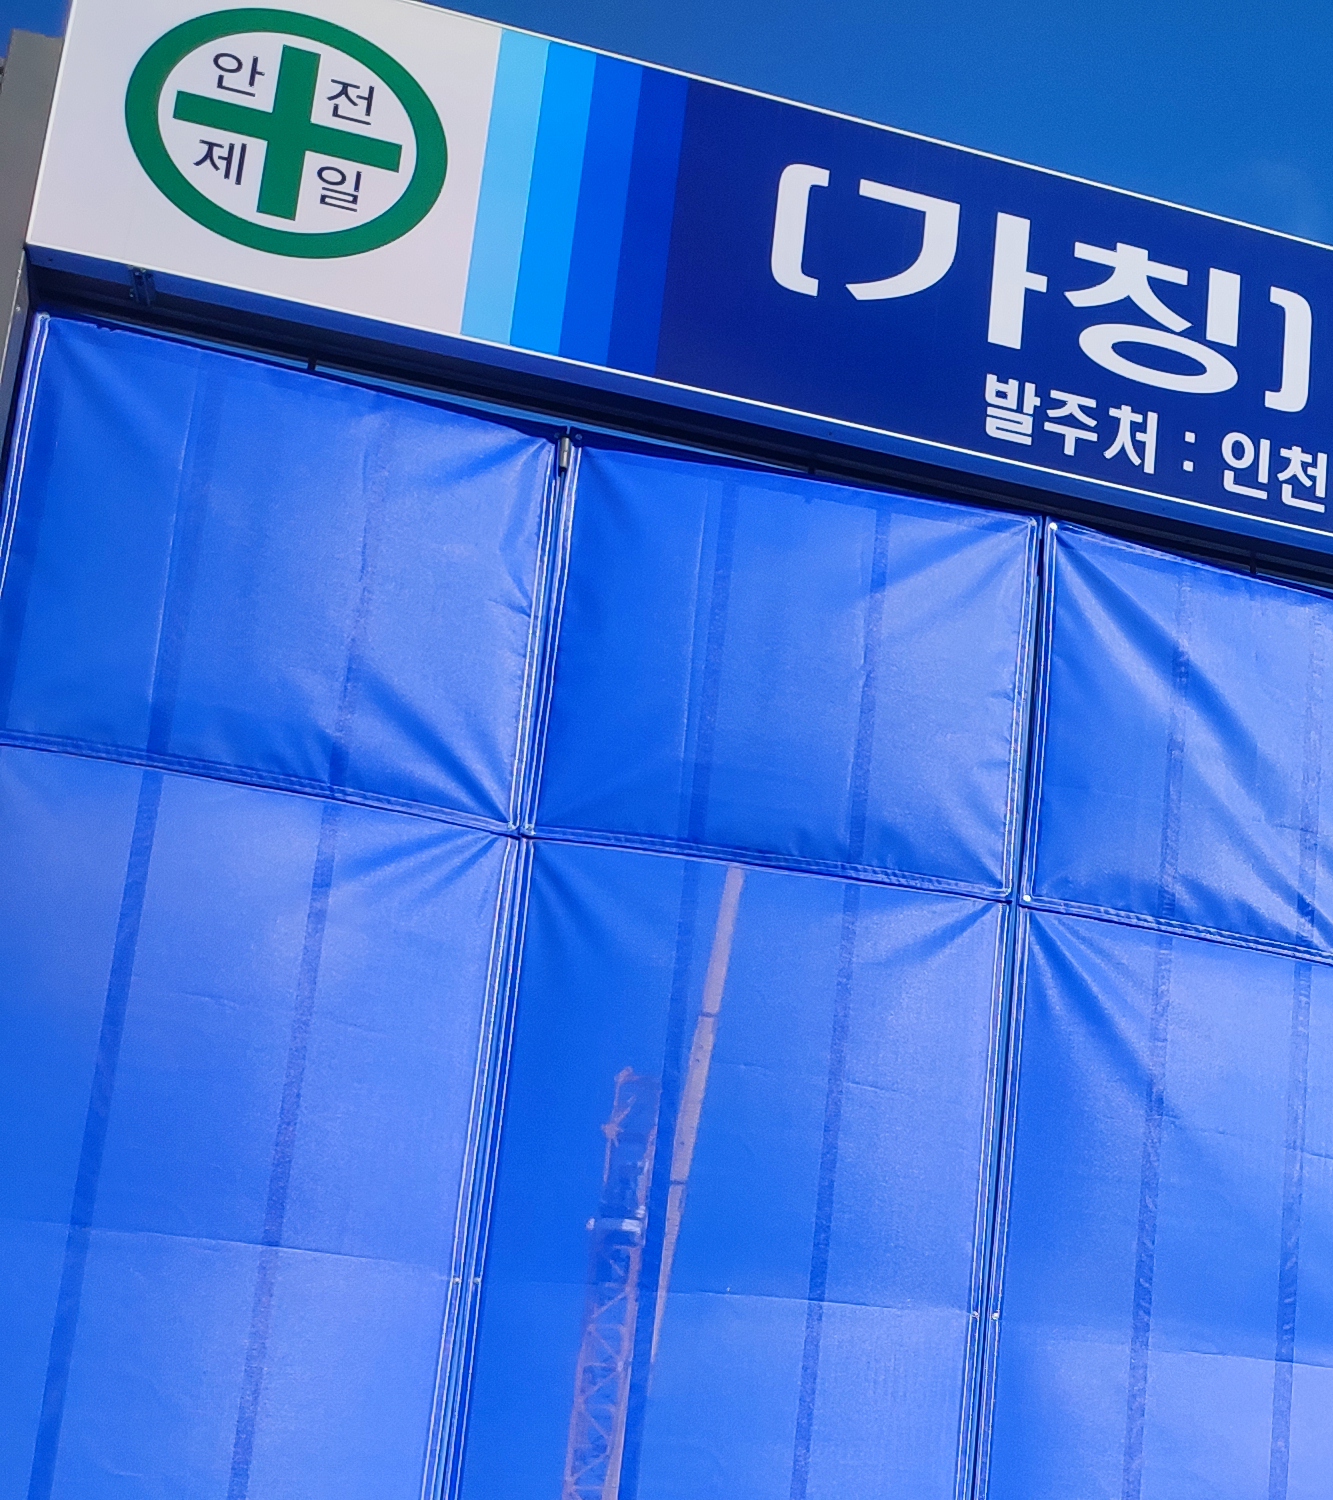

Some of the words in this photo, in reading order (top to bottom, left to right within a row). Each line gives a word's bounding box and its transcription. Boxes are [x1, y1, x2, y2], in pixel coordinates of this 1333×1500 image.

[212, 52, 265, 98] 안
[326, 78, 375, 126] 전
[193, 139, 248, 185] 제
[316, 165, 362, 213] 일
[984, 372, 1159, 475] 발주처
